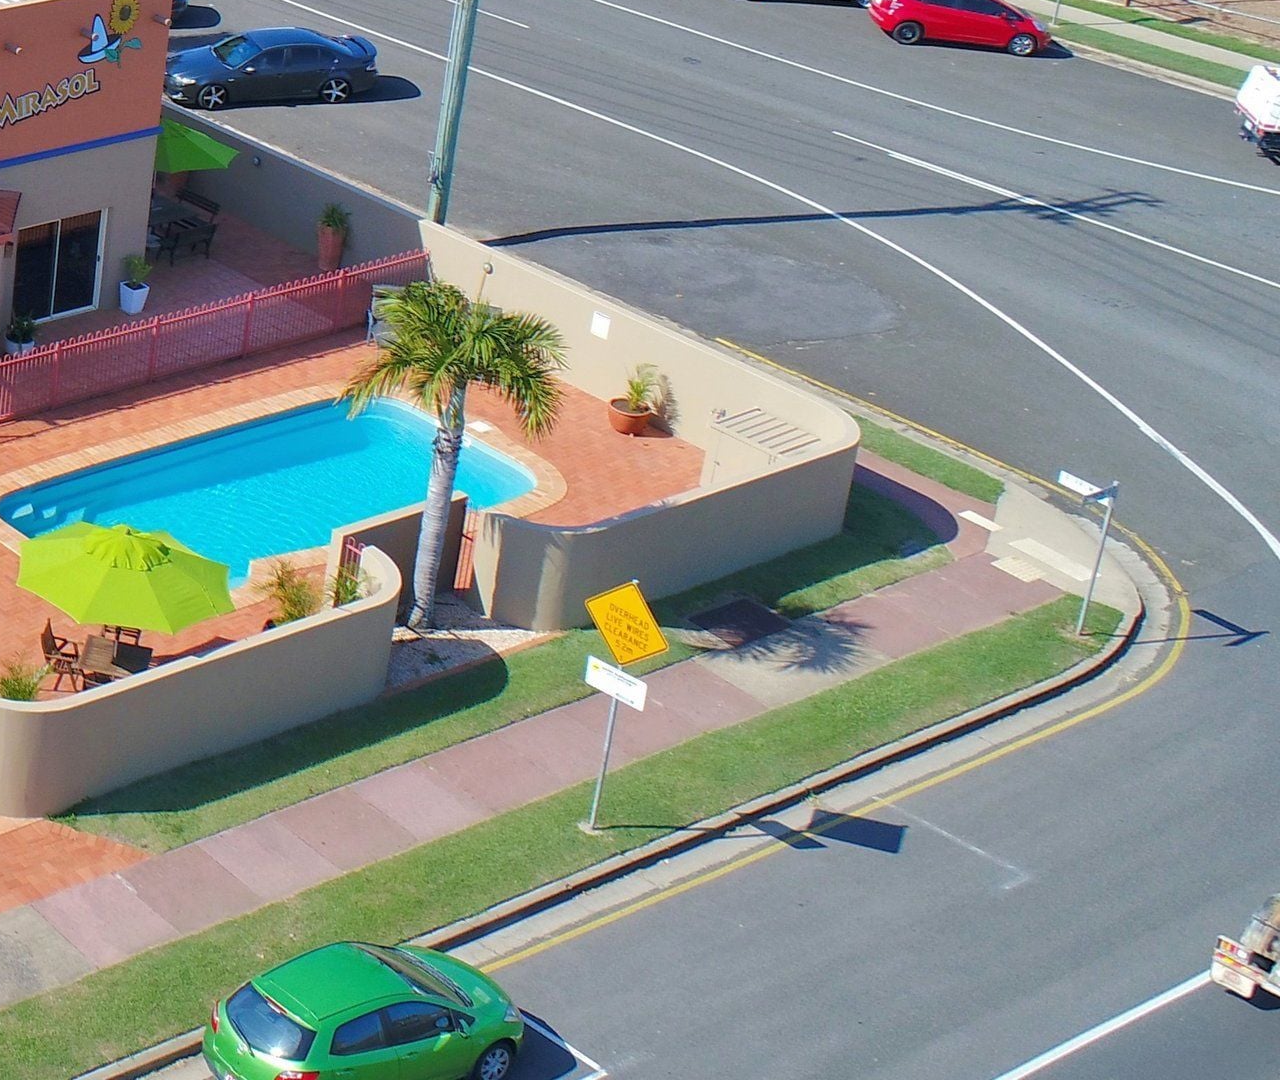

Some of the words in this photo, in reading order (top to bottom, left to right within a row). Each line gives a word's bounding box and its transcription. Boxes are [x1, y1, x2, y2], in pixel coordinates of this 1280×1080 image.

[606, 612, 622, 626] LIVE
[627, 623, 649, 641] WIRES
[609, 603, 649, 630] OVERHEAD
[604, 622, 649, 652] CLEARANCE
